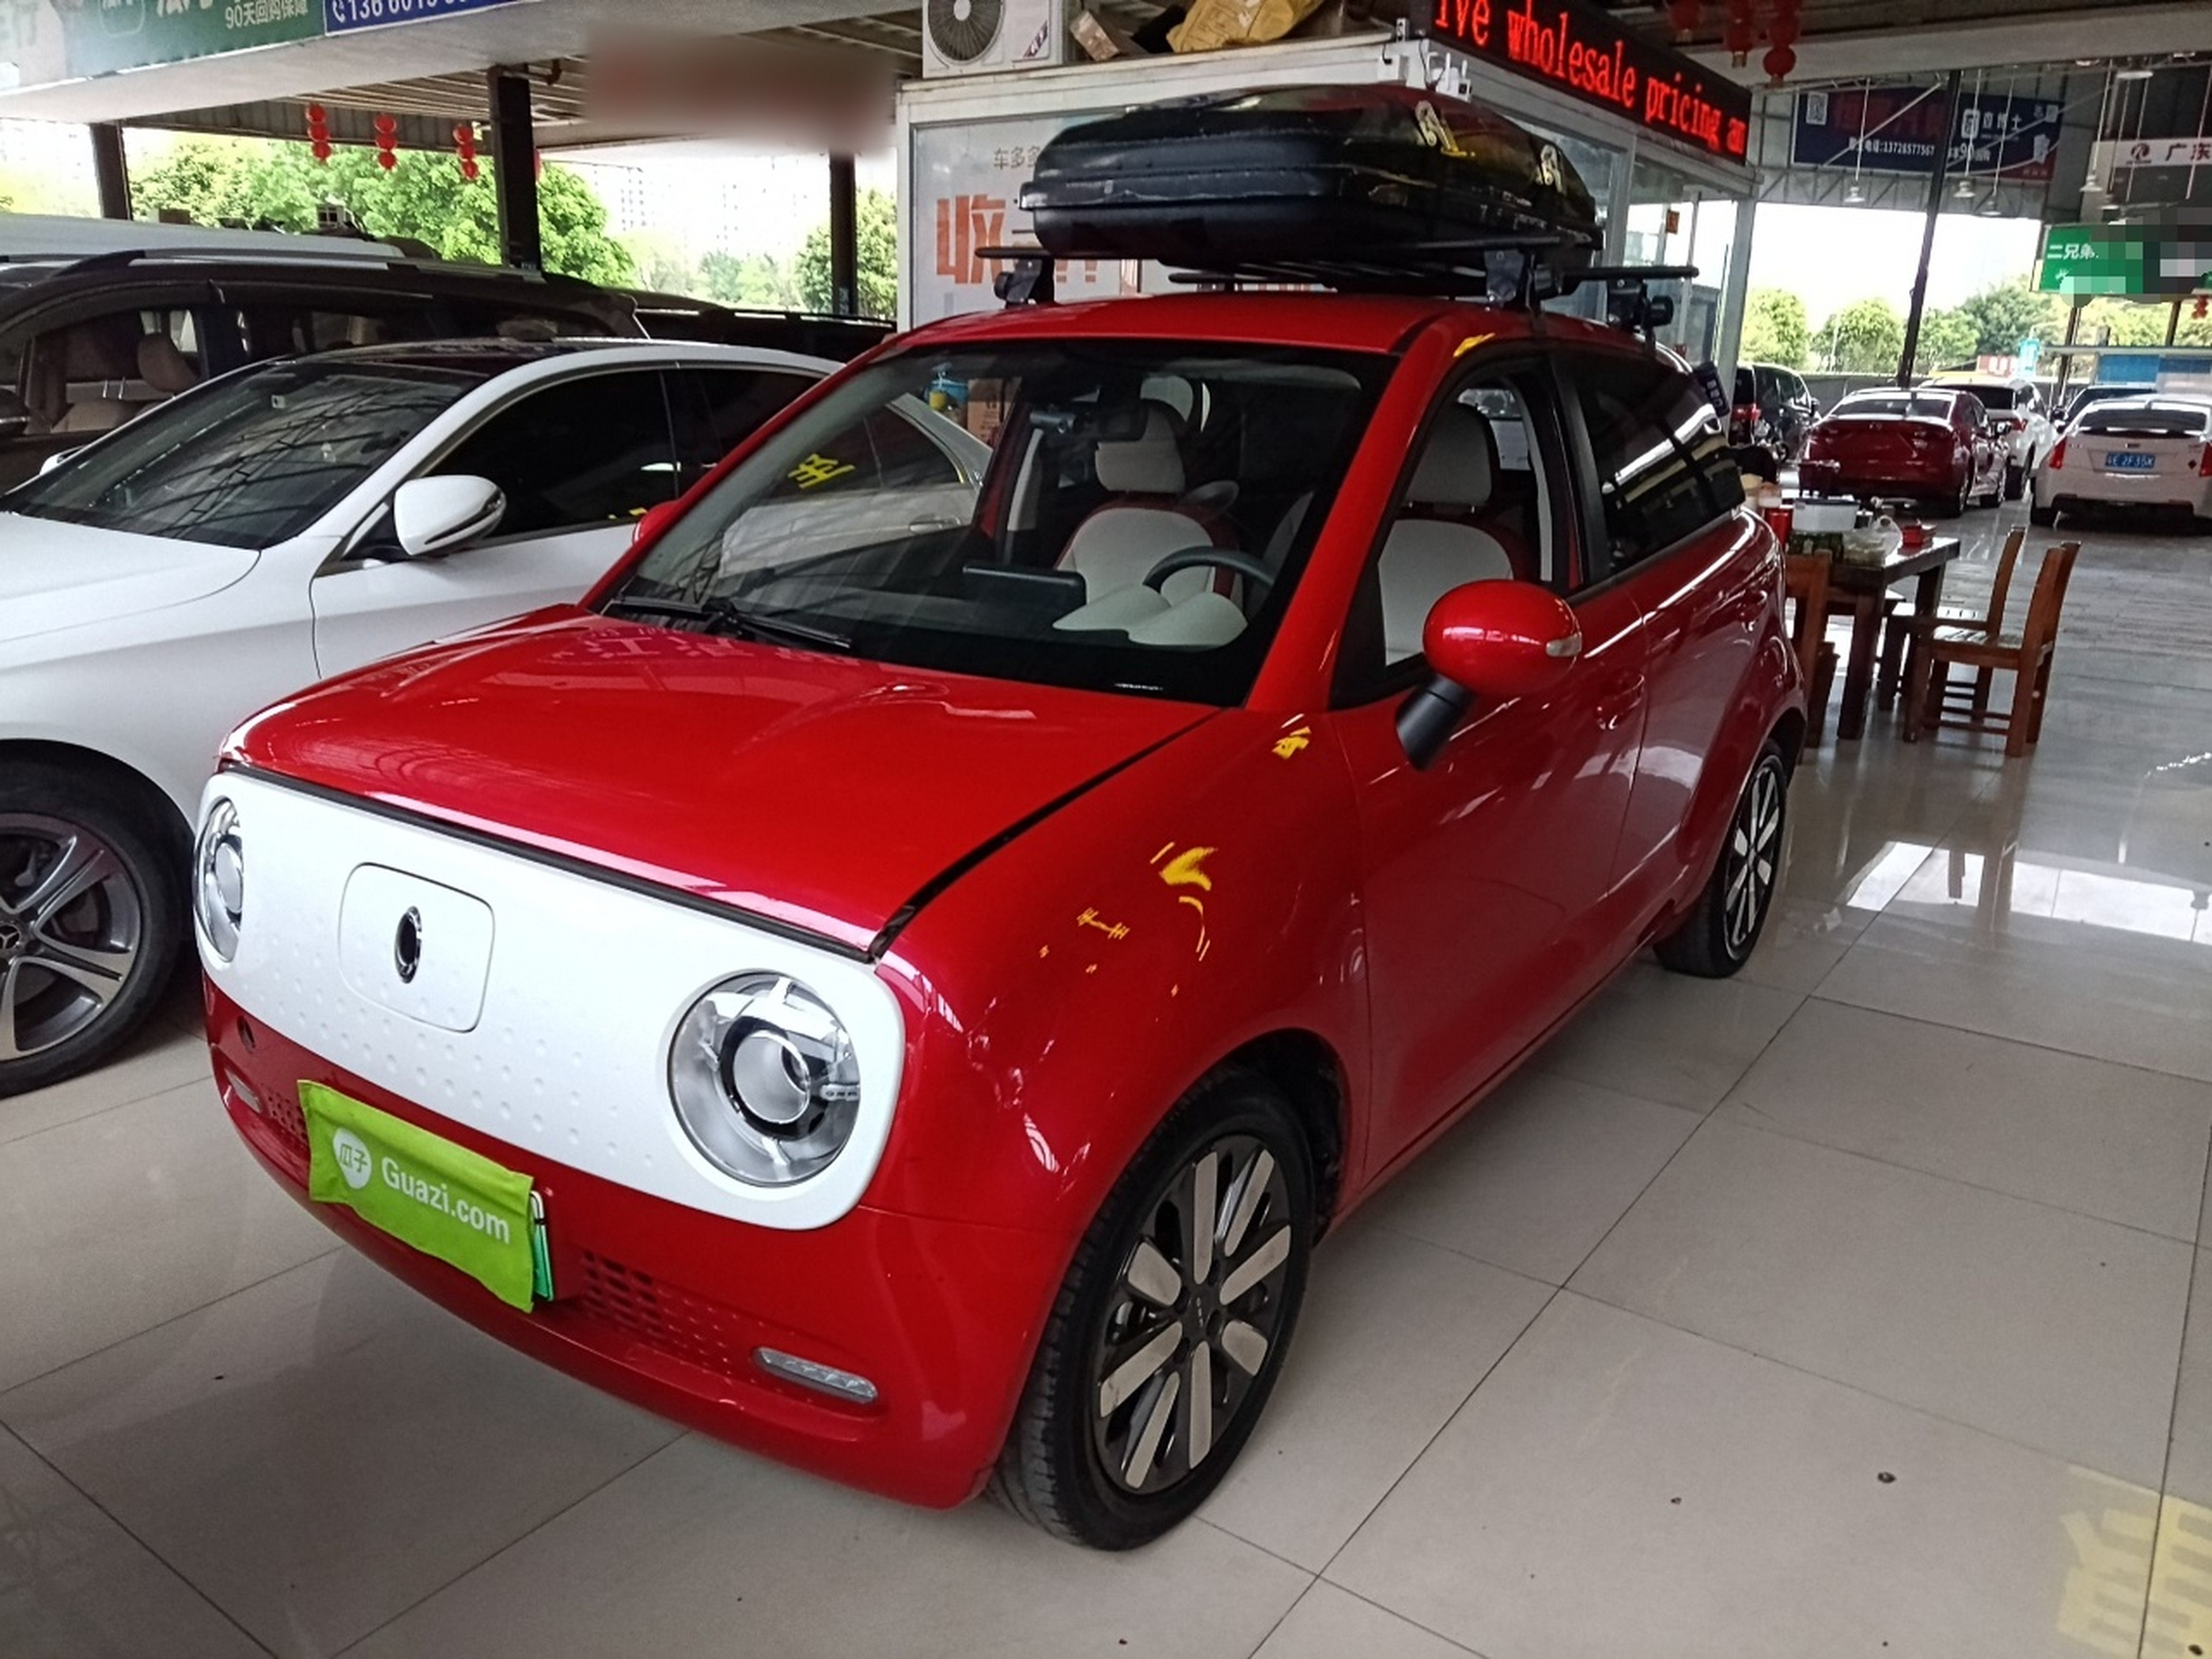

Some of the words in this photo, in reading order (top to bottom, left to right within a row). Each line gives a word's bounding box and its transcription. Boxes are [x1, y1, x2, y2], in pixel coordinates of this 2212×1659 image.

[1507, 0, 1636, 108] wholesale
[1645, 71, 1722, 154] pricing
[339, 1142, 368, 1173] 瓜子
[381, 1156, 510, 1245] Guazi.com
